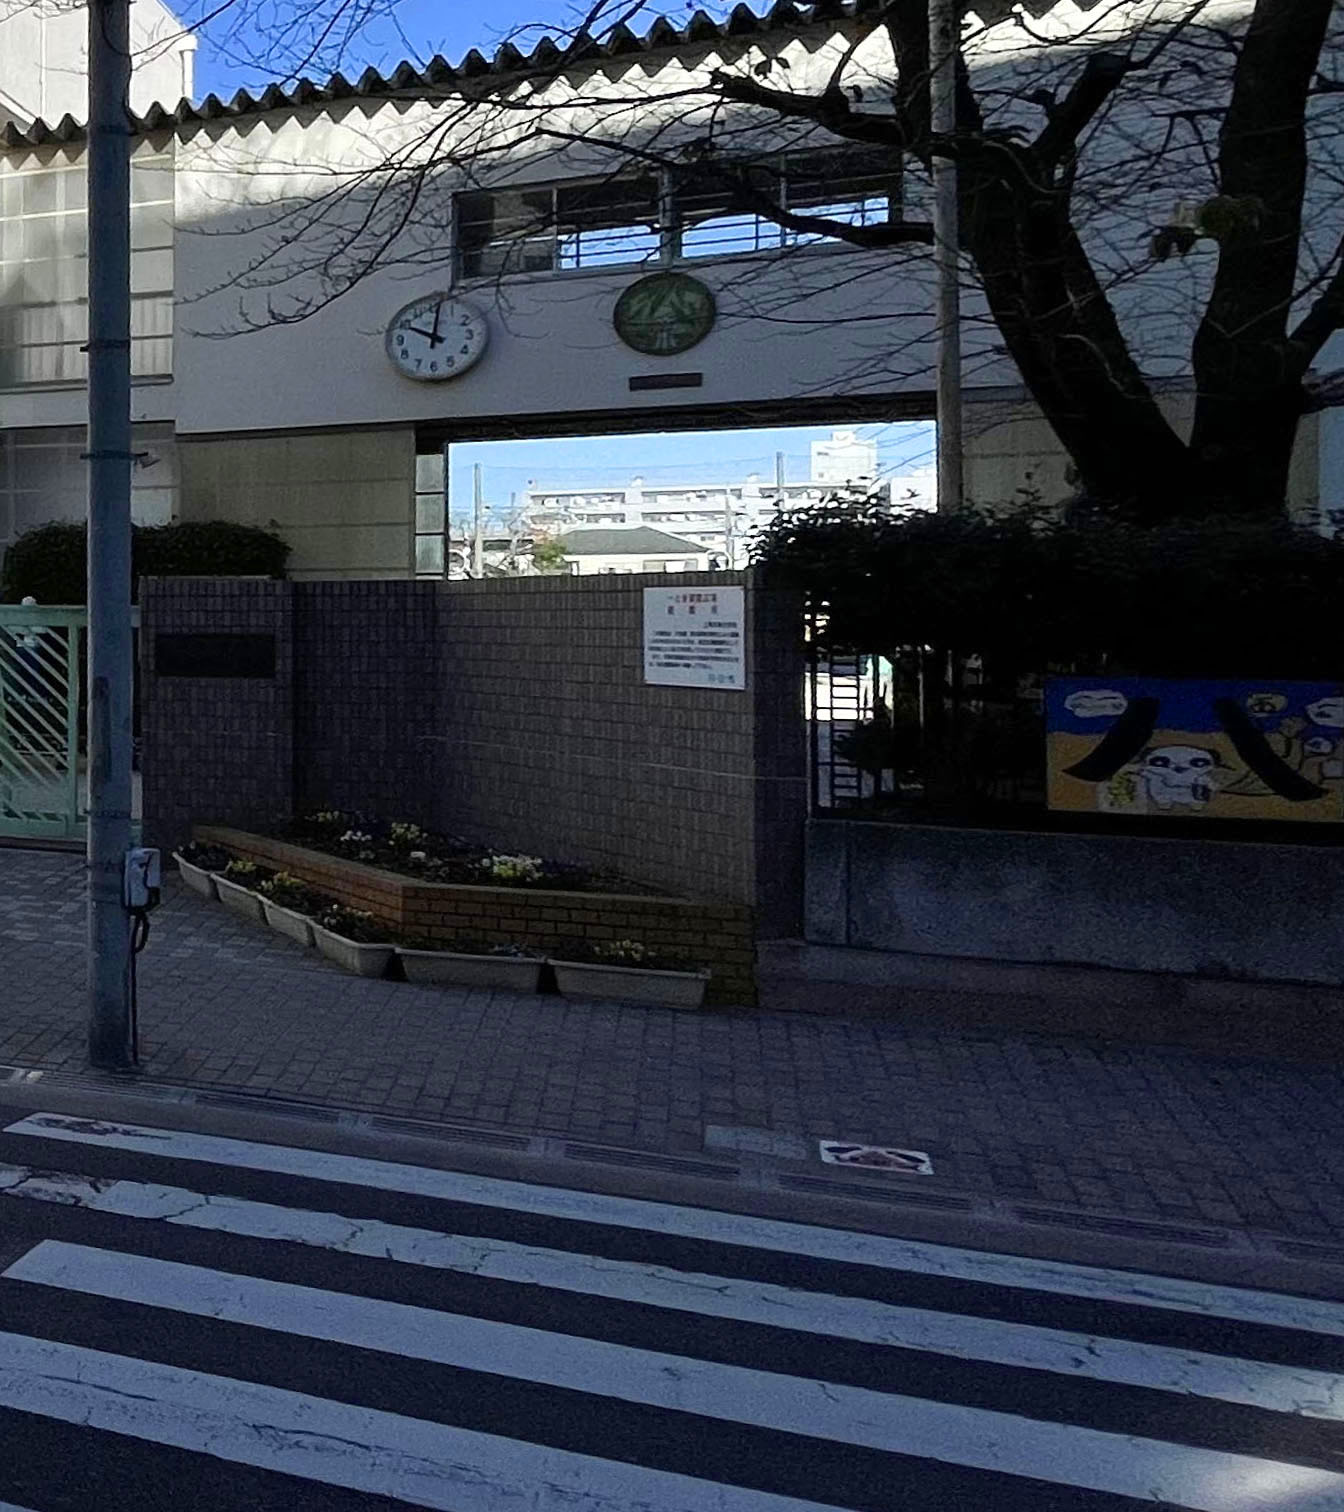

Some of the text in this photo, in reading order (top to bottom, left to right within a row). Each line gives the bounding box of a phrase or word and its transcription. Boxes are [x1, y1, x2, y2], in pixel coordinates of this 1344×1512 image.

[460, 314, 471, 327] 2
[465, 329, 474, 340] 3
[396, 335, 405, 346] 9
[401, 349, 409, 360] 8
[460, 345, 469, 355] 4
[414, 358, 422, 369] 7
[430, 360, 438, 372] 6
[446, 355, 455, 368] 5
